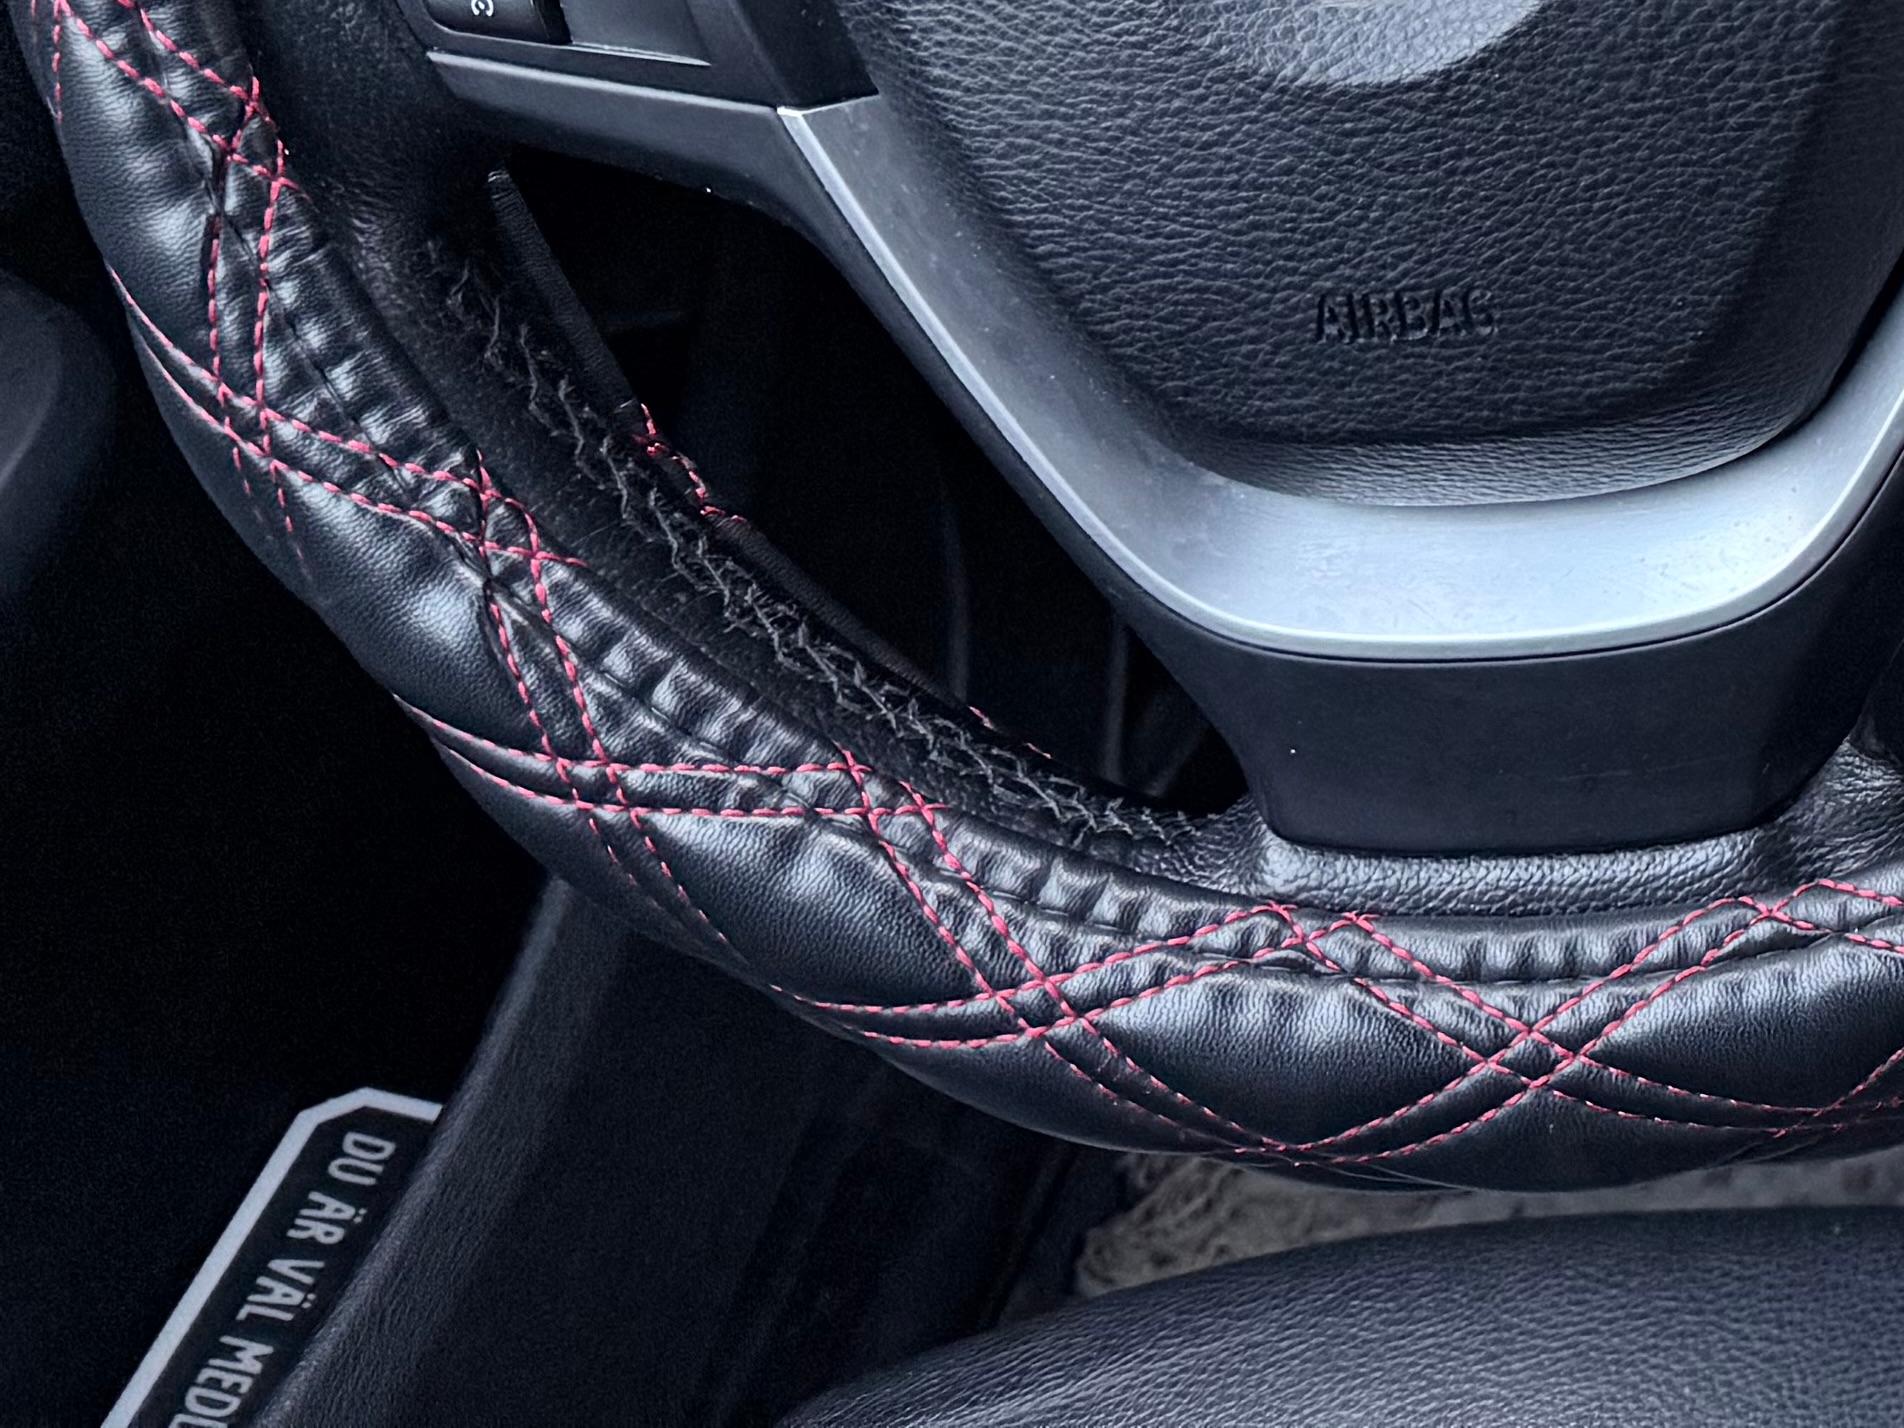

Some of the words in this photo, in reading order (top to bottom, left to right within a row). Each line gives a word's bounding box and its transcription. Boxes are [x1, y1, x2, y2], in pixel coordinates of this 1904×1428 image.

[1315, 291, 1499, 343] AIRBAG
[327, 1130, 397, 1186] DU
[286, 1190, 367, 1245] ÄR
[236, 1257, 325, 1322] VÄL
